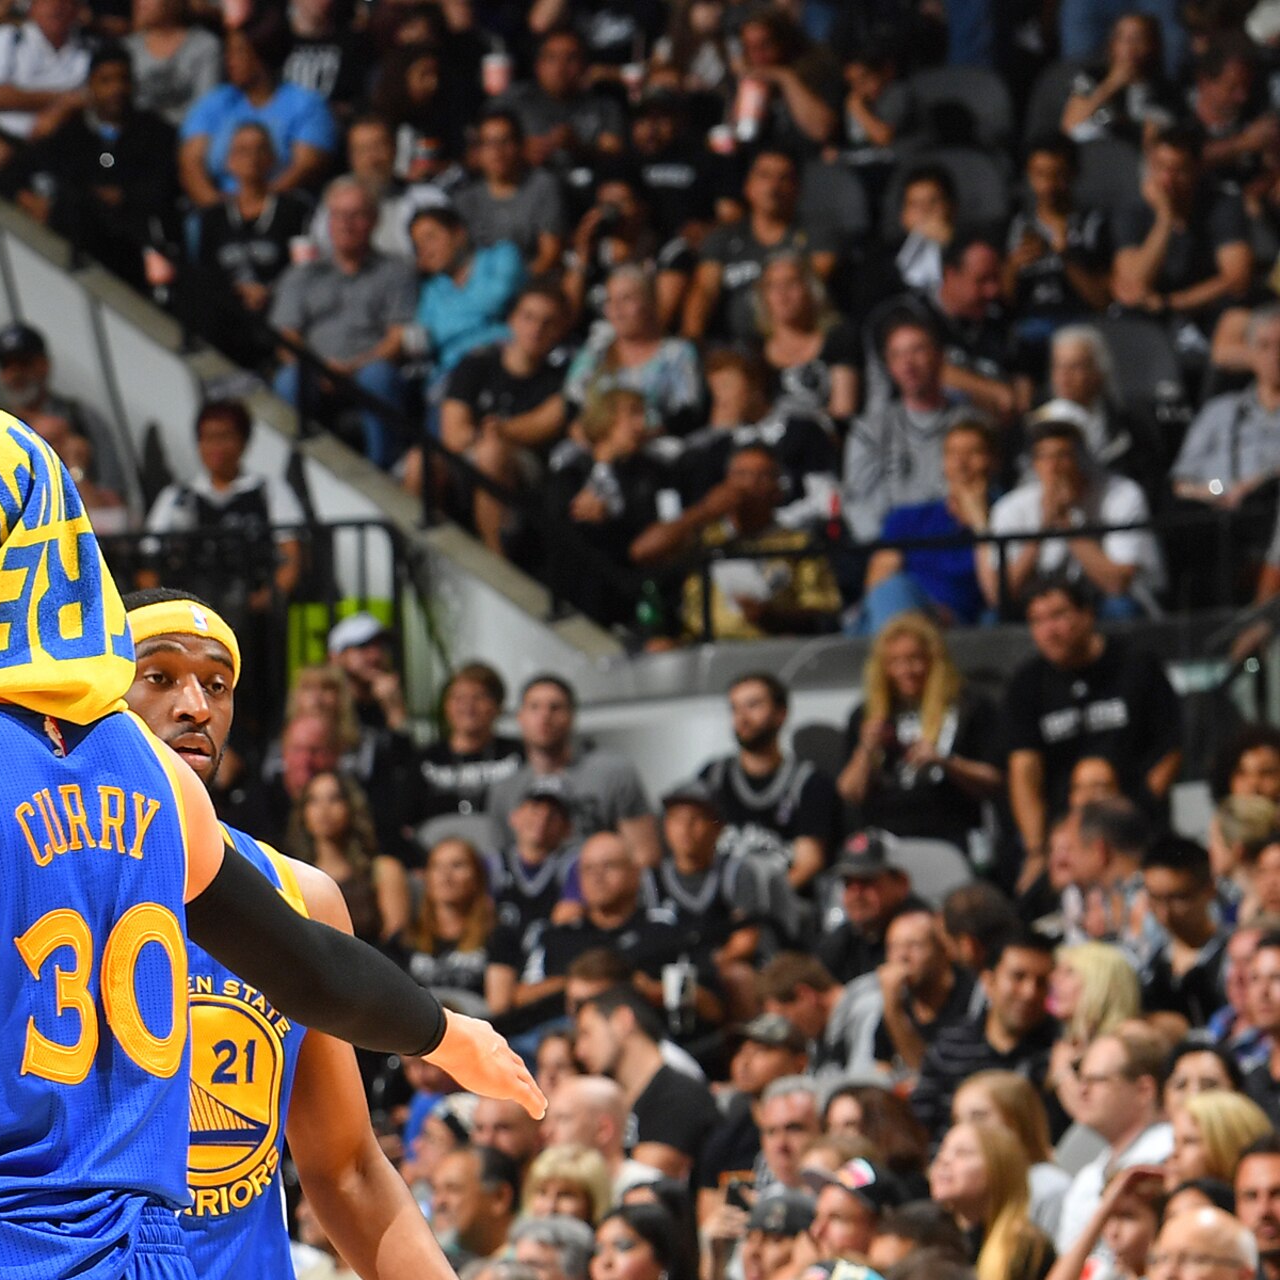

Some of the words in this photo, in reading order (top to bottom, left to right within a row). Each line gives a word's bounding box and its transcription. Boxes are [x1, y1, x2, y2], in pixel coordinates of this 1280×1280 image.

[14, 783, 161, 867] CURRY
[13, 901, 188, 1085] 30
[222, 979, 292, 1038] STATE
[211, 1039, 256, 1085] 21
